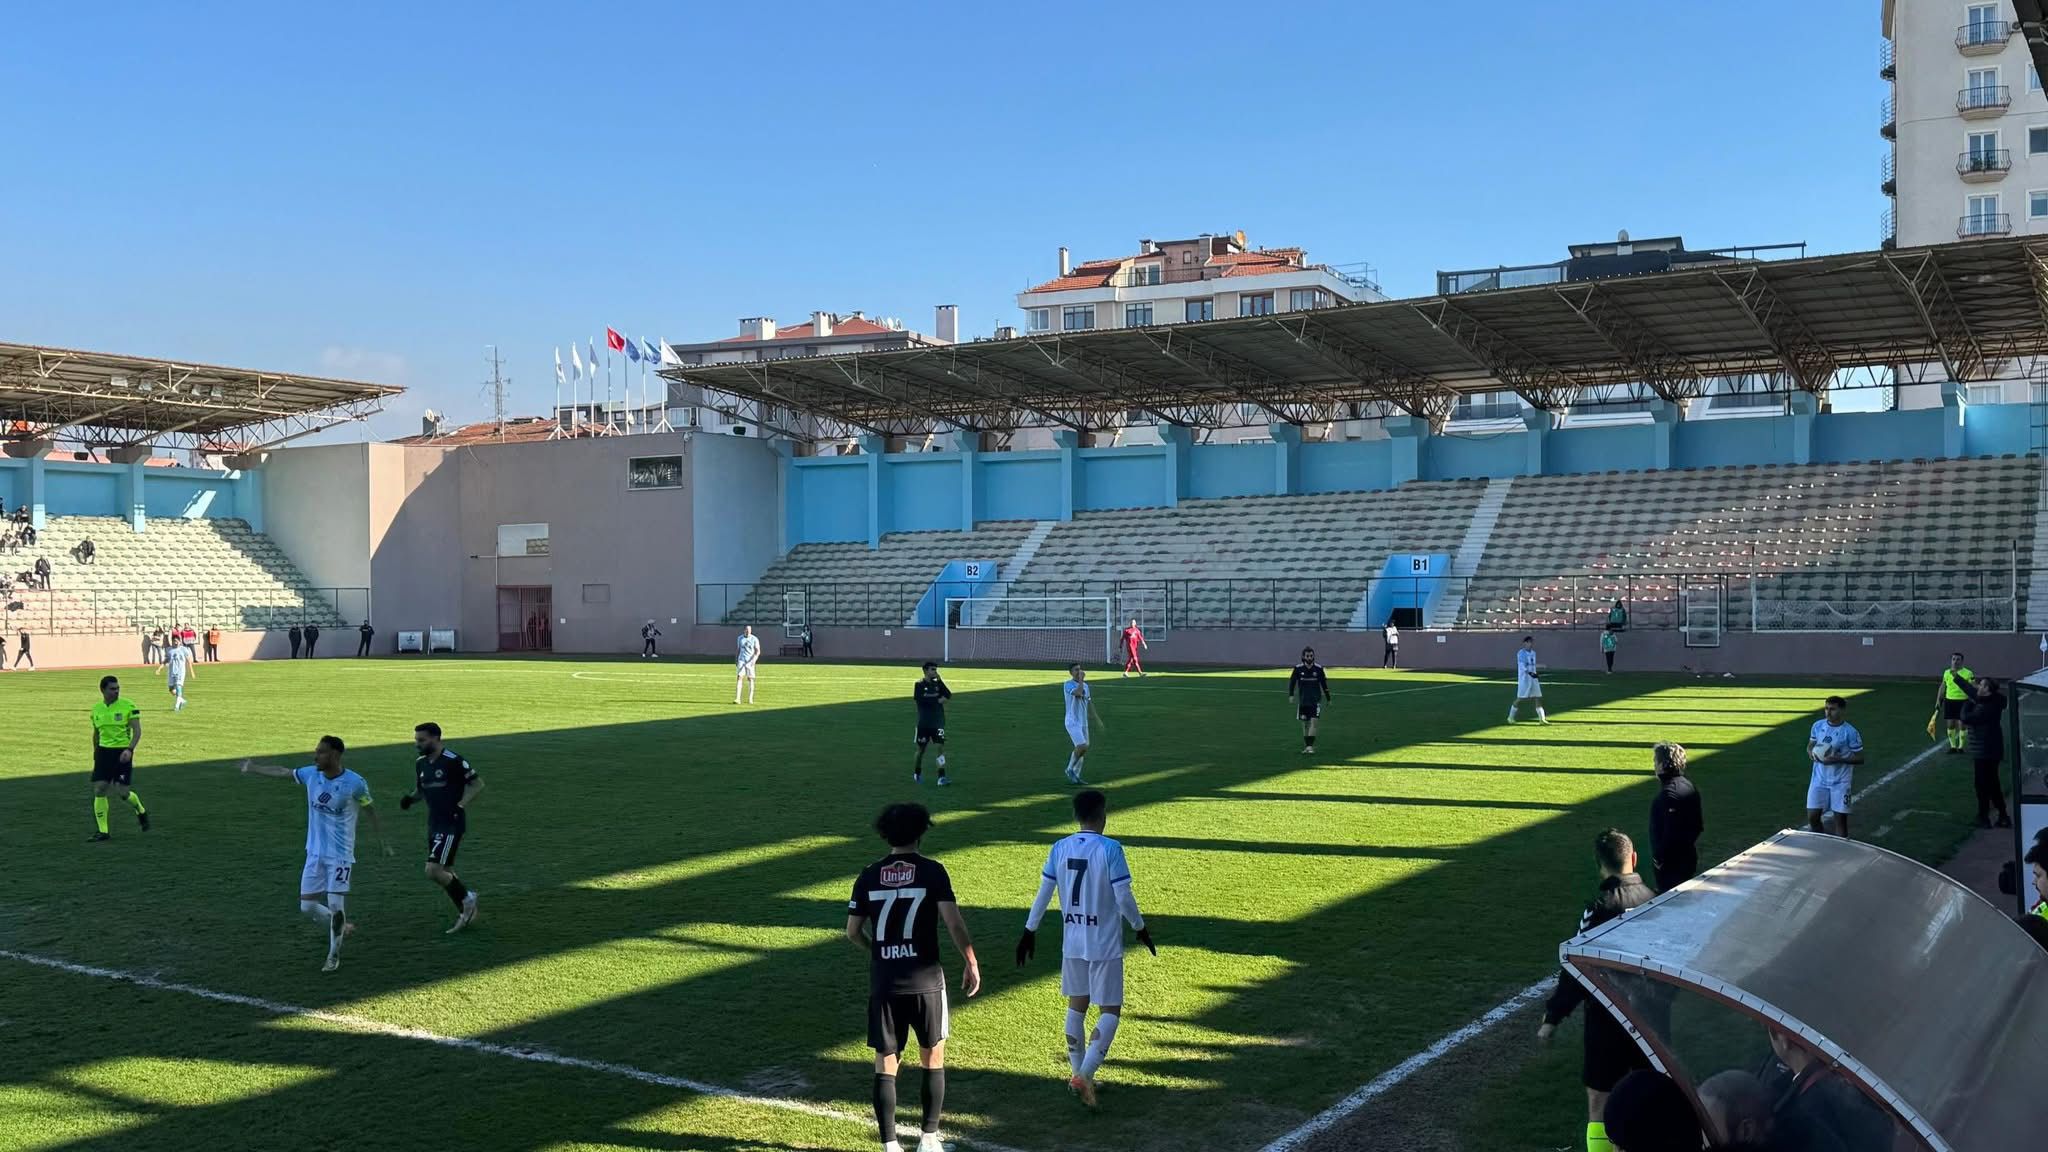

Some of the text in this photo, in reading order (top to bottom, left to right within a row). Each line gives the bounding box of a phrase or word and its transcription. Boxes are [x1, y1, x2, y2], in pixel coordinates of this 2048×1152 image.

[966, 565, 979, 576] B2
[1413, 558, 1427, 571] B1
[335, 866, 351, 881] 27
[1067, 857, 1088, 907] 7
[868, 887, 927, 942] 77
[880, 943, 918, 960] URAL
